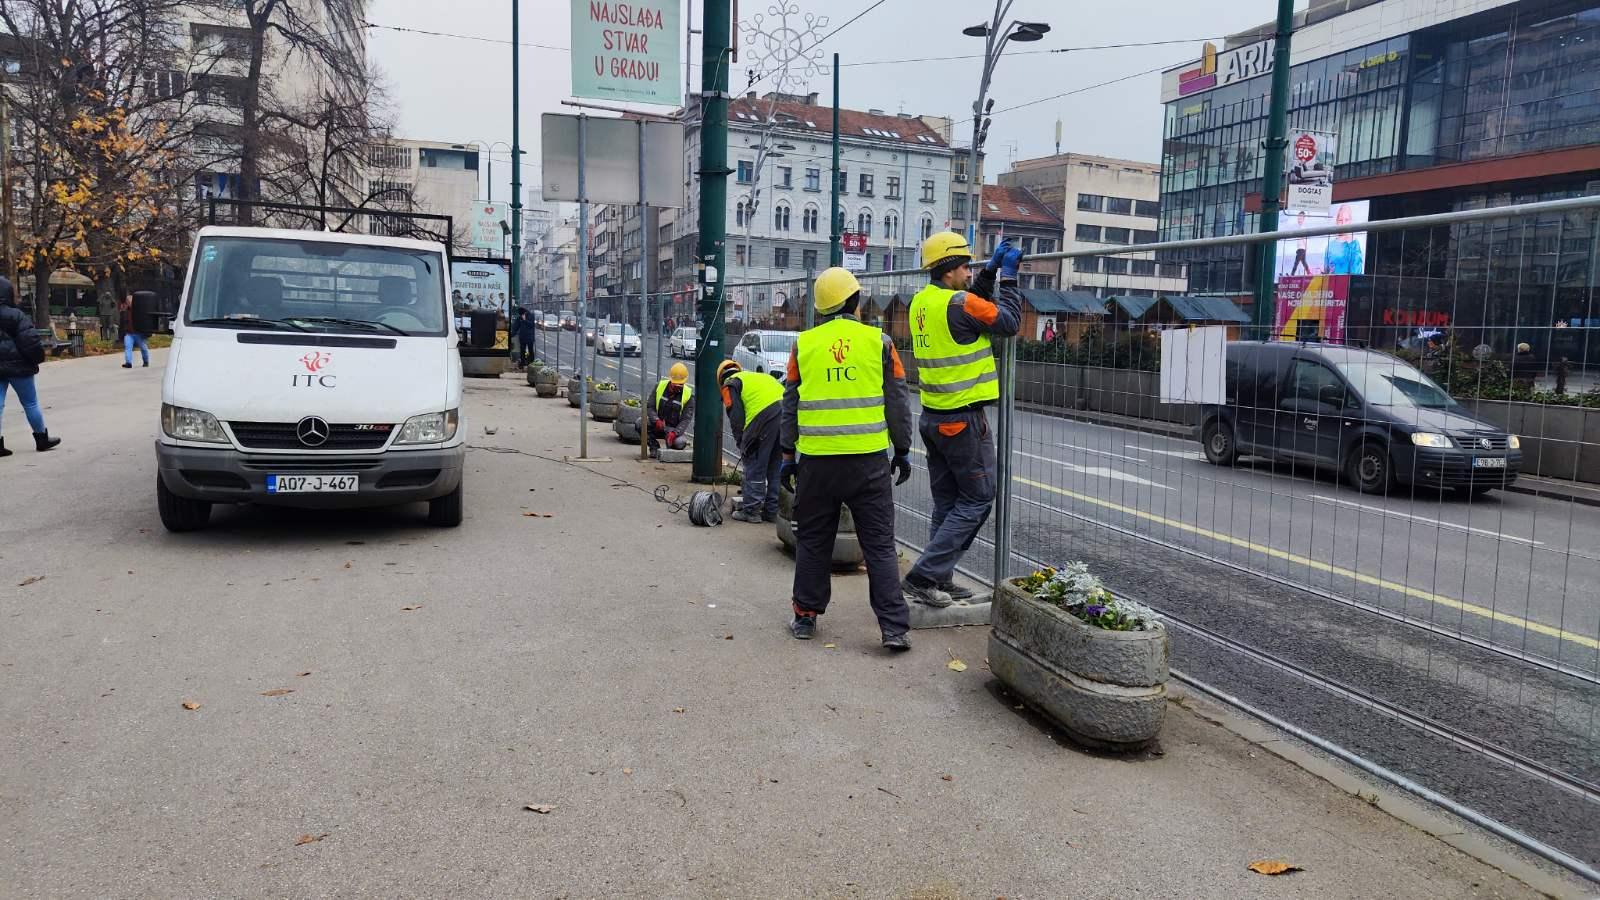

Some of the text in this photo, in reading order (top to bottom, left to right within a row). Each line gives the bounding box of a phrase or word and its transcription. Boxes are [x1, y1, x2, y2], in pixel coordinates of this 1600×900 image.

[590, 0, 663, 30] NAJSLAĐA
[603, 29, 648, 54] STVAR
[594, 55, 659, 82] U GRADU!
[915, 334, 930, 348] ITC
[293, 374, 336, 387] ITC
[827, 366, 856, 382] ITC
[278, 475, 355, 491] A07-J-467
